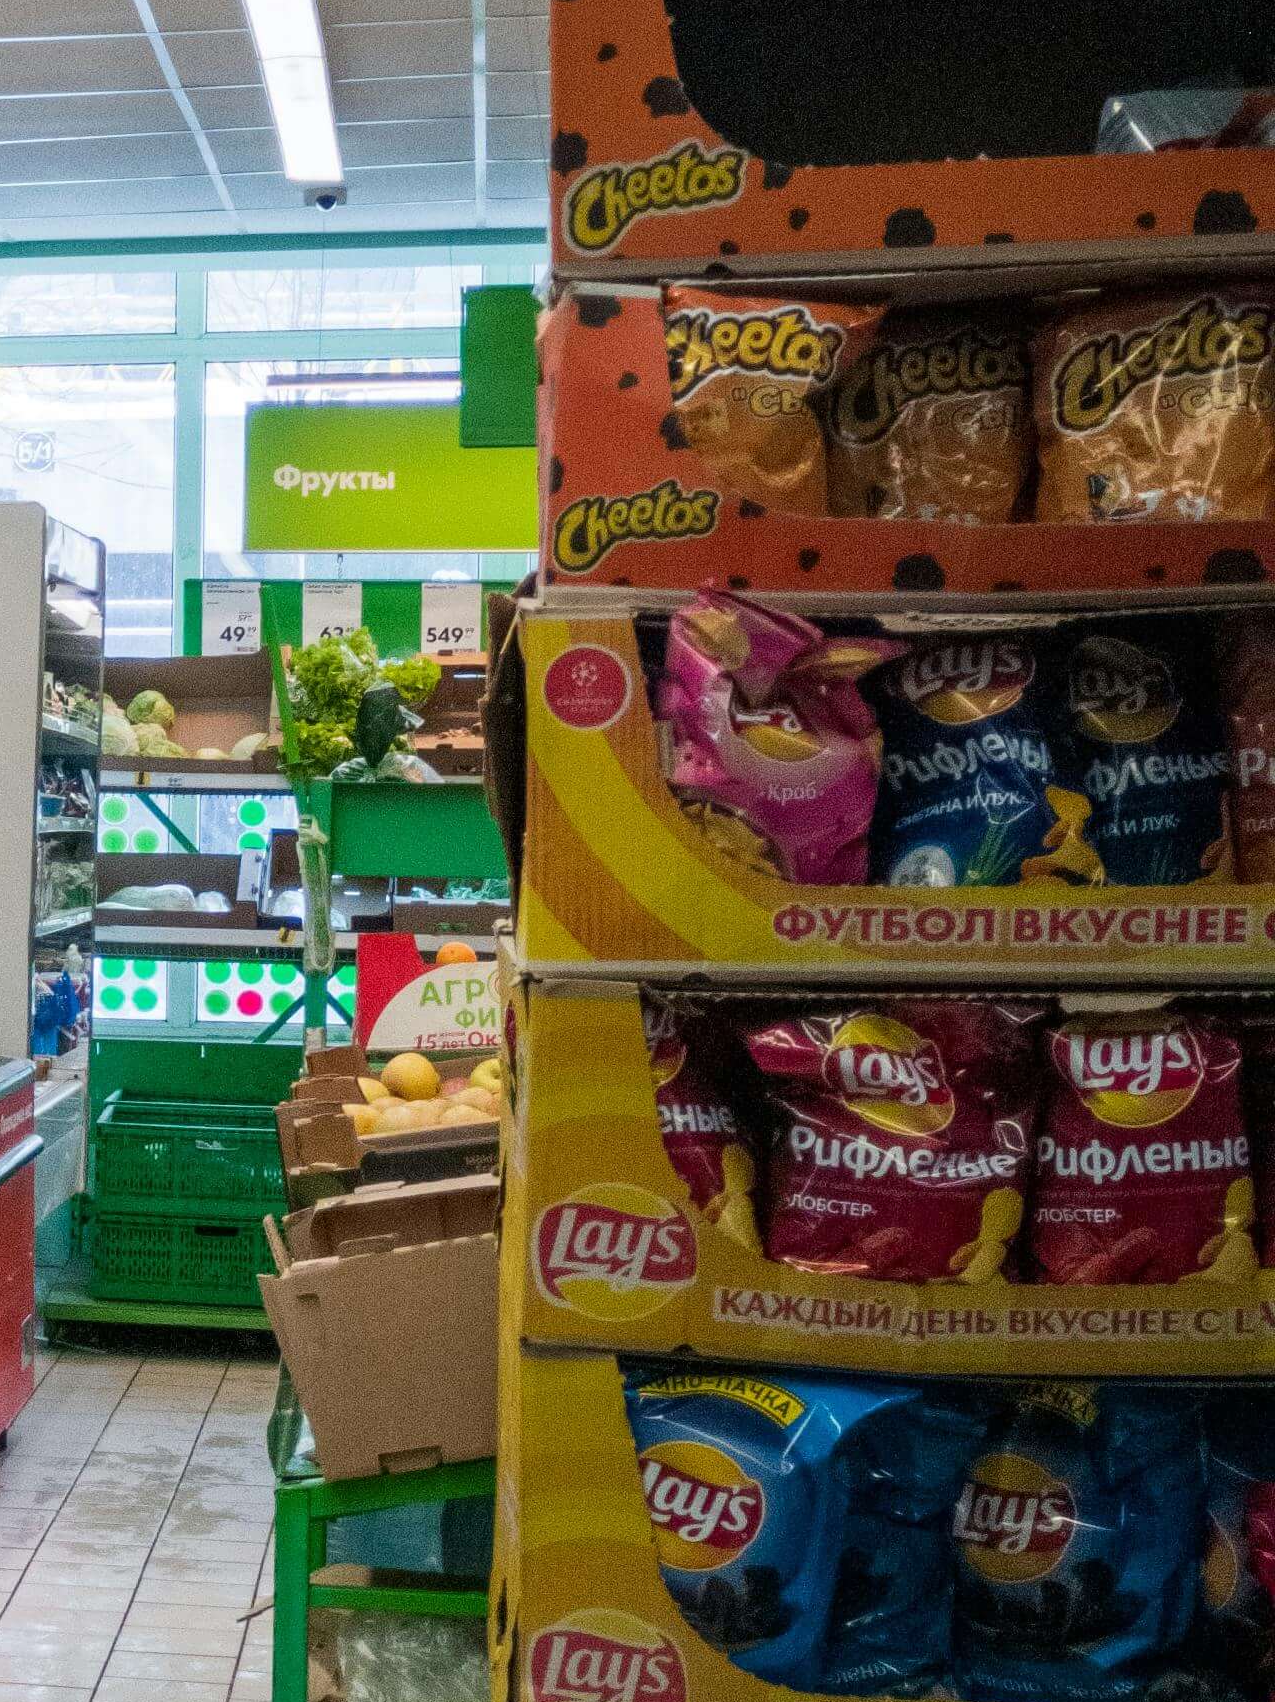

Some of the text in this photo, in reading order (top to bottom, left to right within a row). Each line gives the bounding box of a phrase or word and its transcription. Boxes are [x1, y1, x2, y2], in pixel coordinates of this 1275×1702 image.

[574, 147, 742, 247] Cheetos
[1057, 303, 1269, 430] Cheetos
[273, 464, 396, 497] Фрукты
[555, 481, 719, 574] Cheetos
[220, 625, 245, 643] 49
[426, 626, 464, 643] 549
[773, 905, 1248, 947] ФУТБОЛ ВКУСНЕЕ
[837, 1045, 942, 1107] Lay's
[1069, 1027, 1197, 1095] Lay's
[791, 1125, 1017, 1181] Рифленые
[1038, 1135, 1249, 1186] Рифленые
[791, 1193, 872, 1217] ЛОБСТЕР
[548, 1199, 685, 1283] Lay's
[718, 1287, 892, 1332] КАЖДЫЙ
[900, 1300, 995, 1339] ДЕНЬ
[1008, 1305, 1182, 1337] ВКУСНЕЕ
